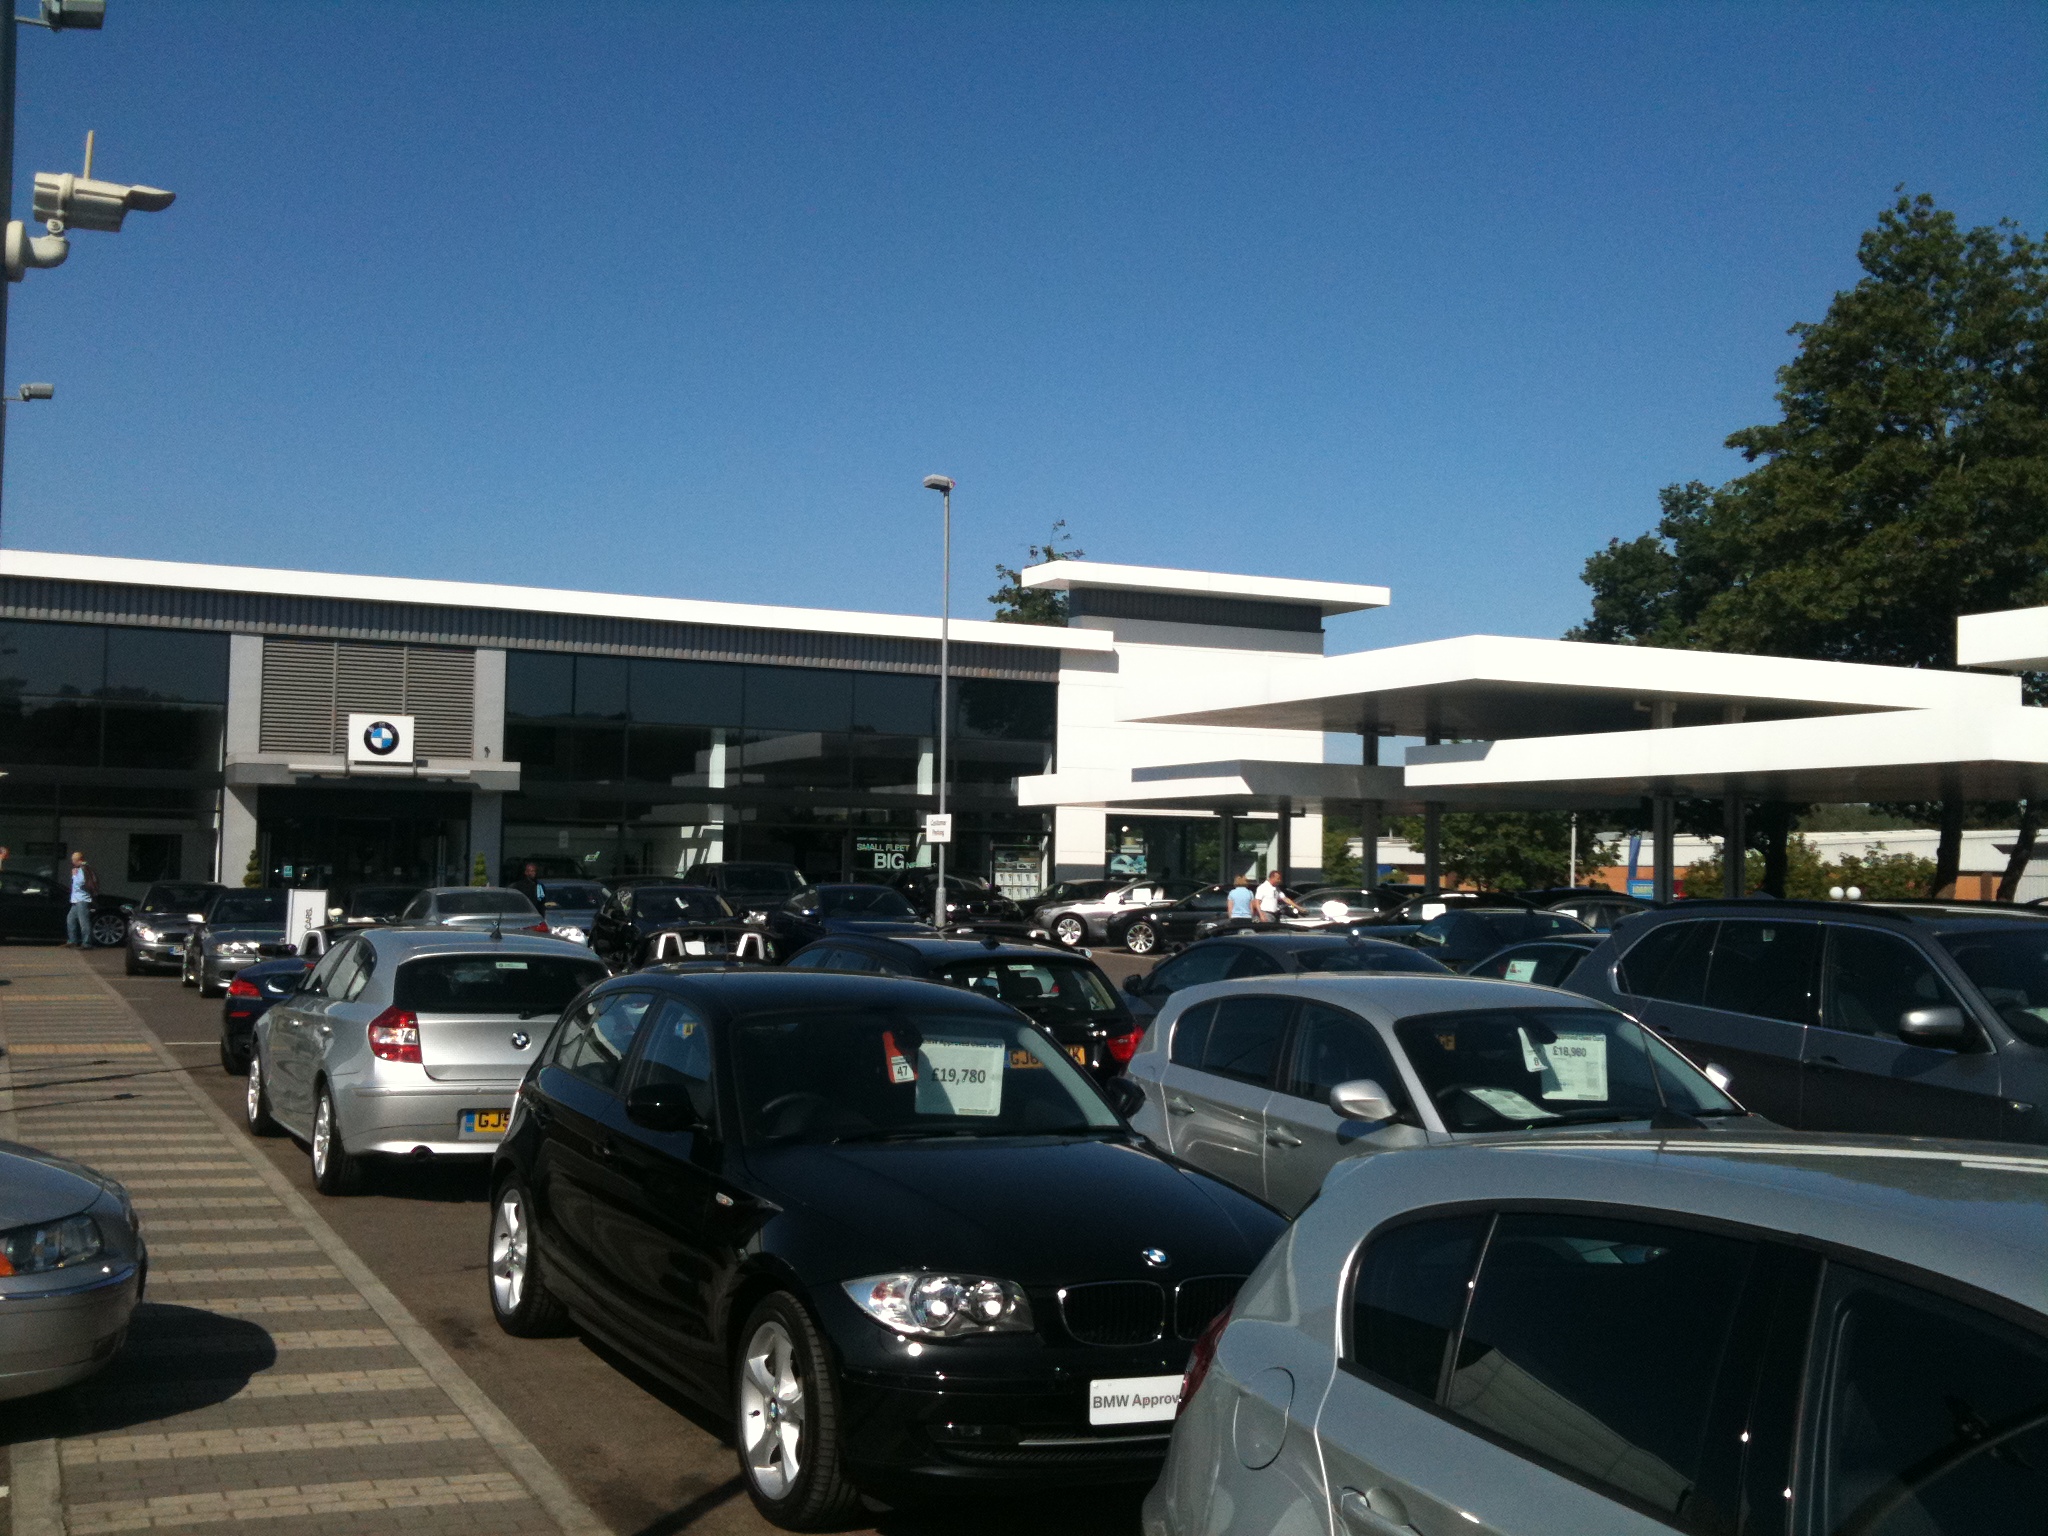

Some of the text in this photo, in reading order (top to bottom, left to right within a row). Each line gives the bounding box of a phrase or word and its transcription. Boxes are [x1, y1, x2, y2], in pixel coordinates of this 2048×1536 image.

[856, 843, 885, 851] SMALL
[874, 853, 905, 869] BIG
[896, 1065, 908, 1077] 47
[931, 1067, 986, 1085] £19,780
[1093, 1394, 1130, 1409] BMW
